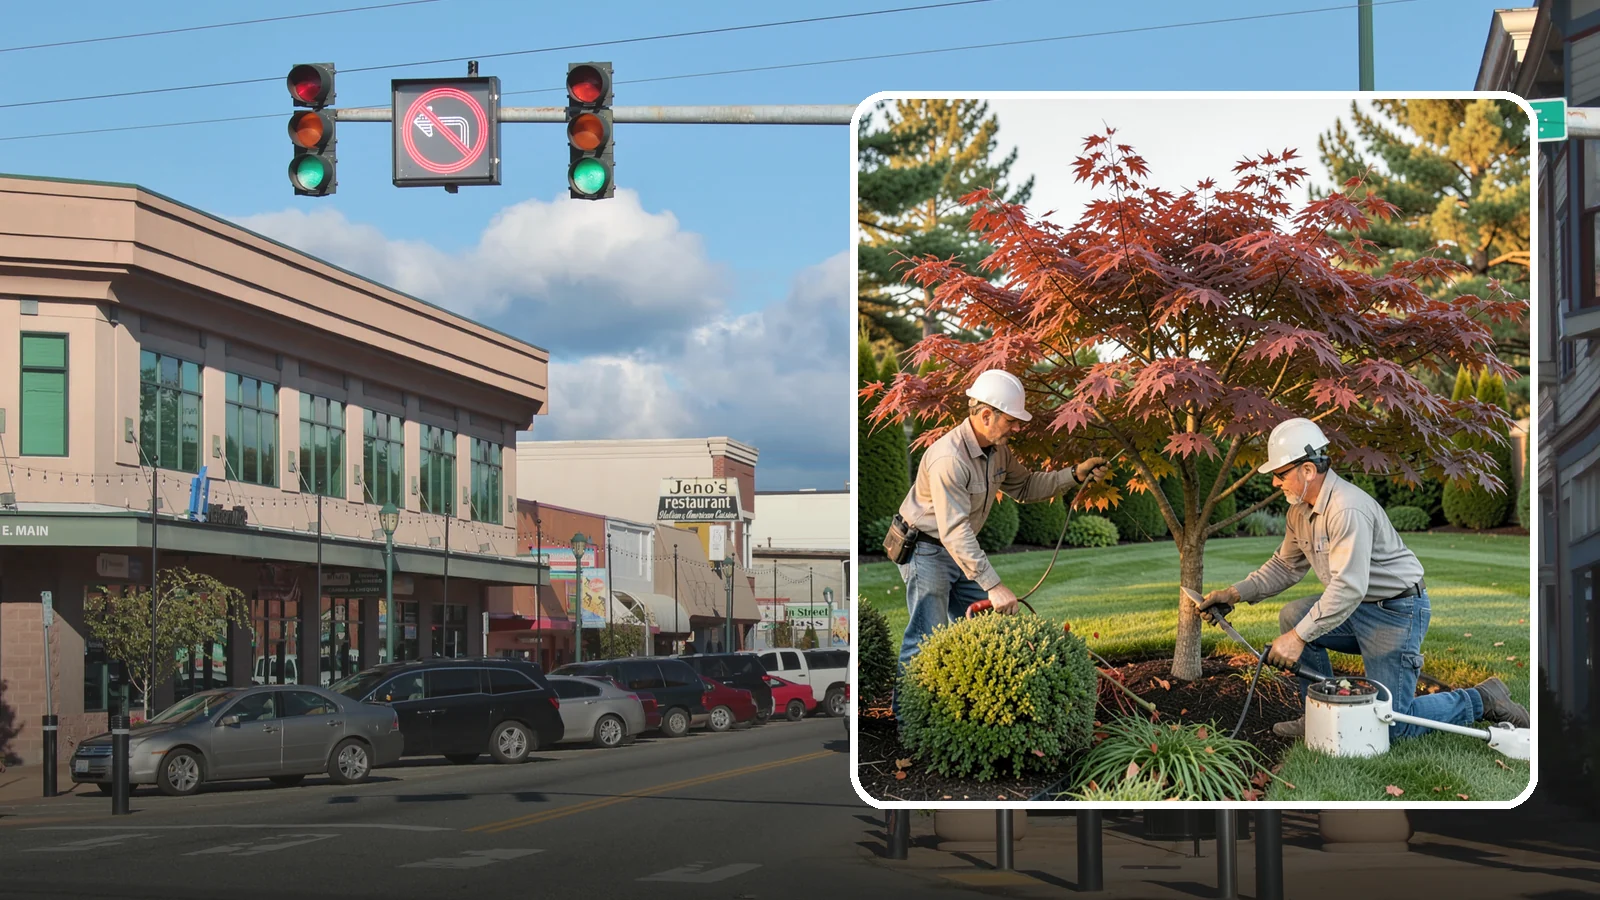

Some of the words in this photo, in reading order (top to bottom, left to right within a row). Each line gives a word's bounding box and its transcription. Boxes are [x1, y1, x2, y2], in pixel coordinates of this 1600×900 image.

[670, 480, 728, 494] Jeno's
[665, 497, 731, 509] restaurant
[658, 510, 681, 519] Italian
[685, 509, 714, 519] American
[714, 509, 738, 519] Cuisine
[2, 525, 13, 536] E.
[15, 525, 49, 536] MAIN
[797, 608, 828, 616] Street
